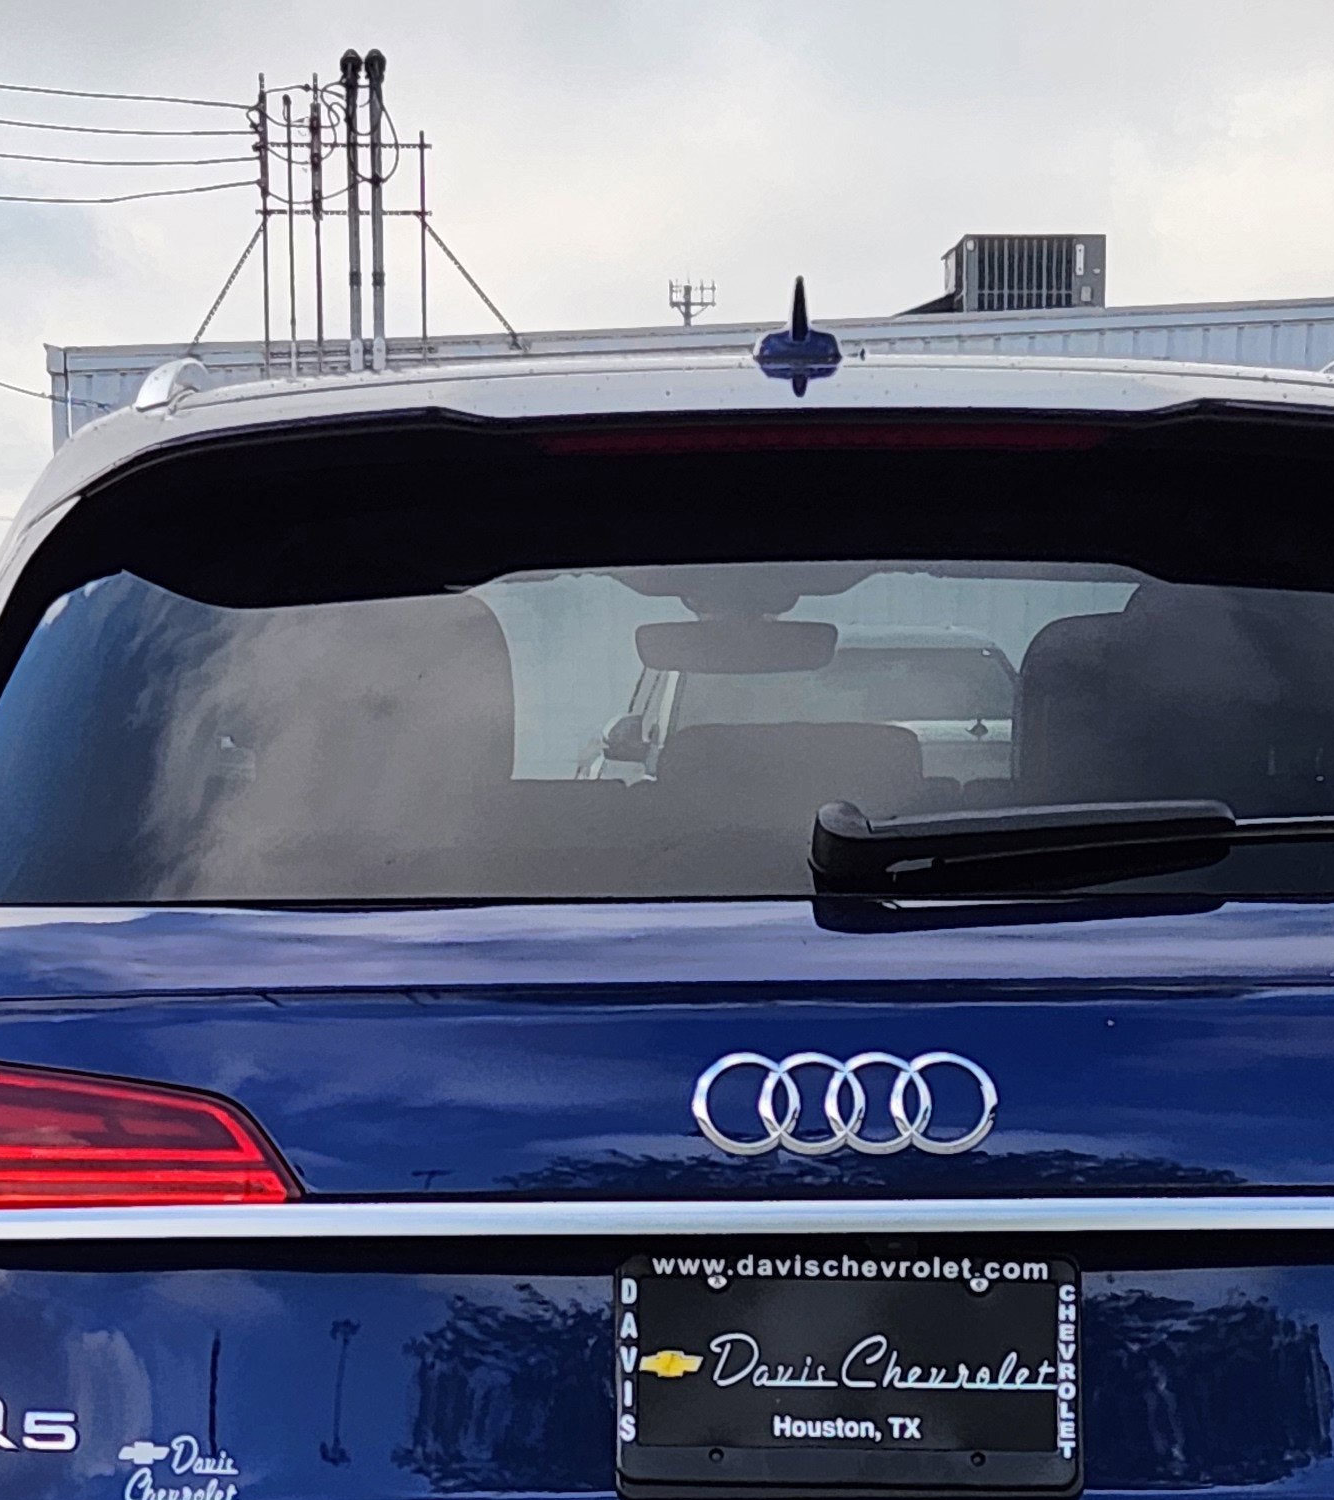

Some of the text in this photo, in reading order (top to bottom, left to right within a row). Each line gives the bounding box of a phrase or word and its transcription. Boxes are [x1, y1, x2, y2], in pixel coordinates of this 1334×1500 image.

[651, 1253, 1049, 1281] www.davischevrolet.com
[619, 1277, 639, 1443] DAVIS
[709, 1332, 1058, 1391] Davis Chevrolet
[1057, 1284, 1077, 1459] CHEVROLET
[772, 1415, 922, 1443] Houston, TX
[170, 1434, 240, 1475] Davis
